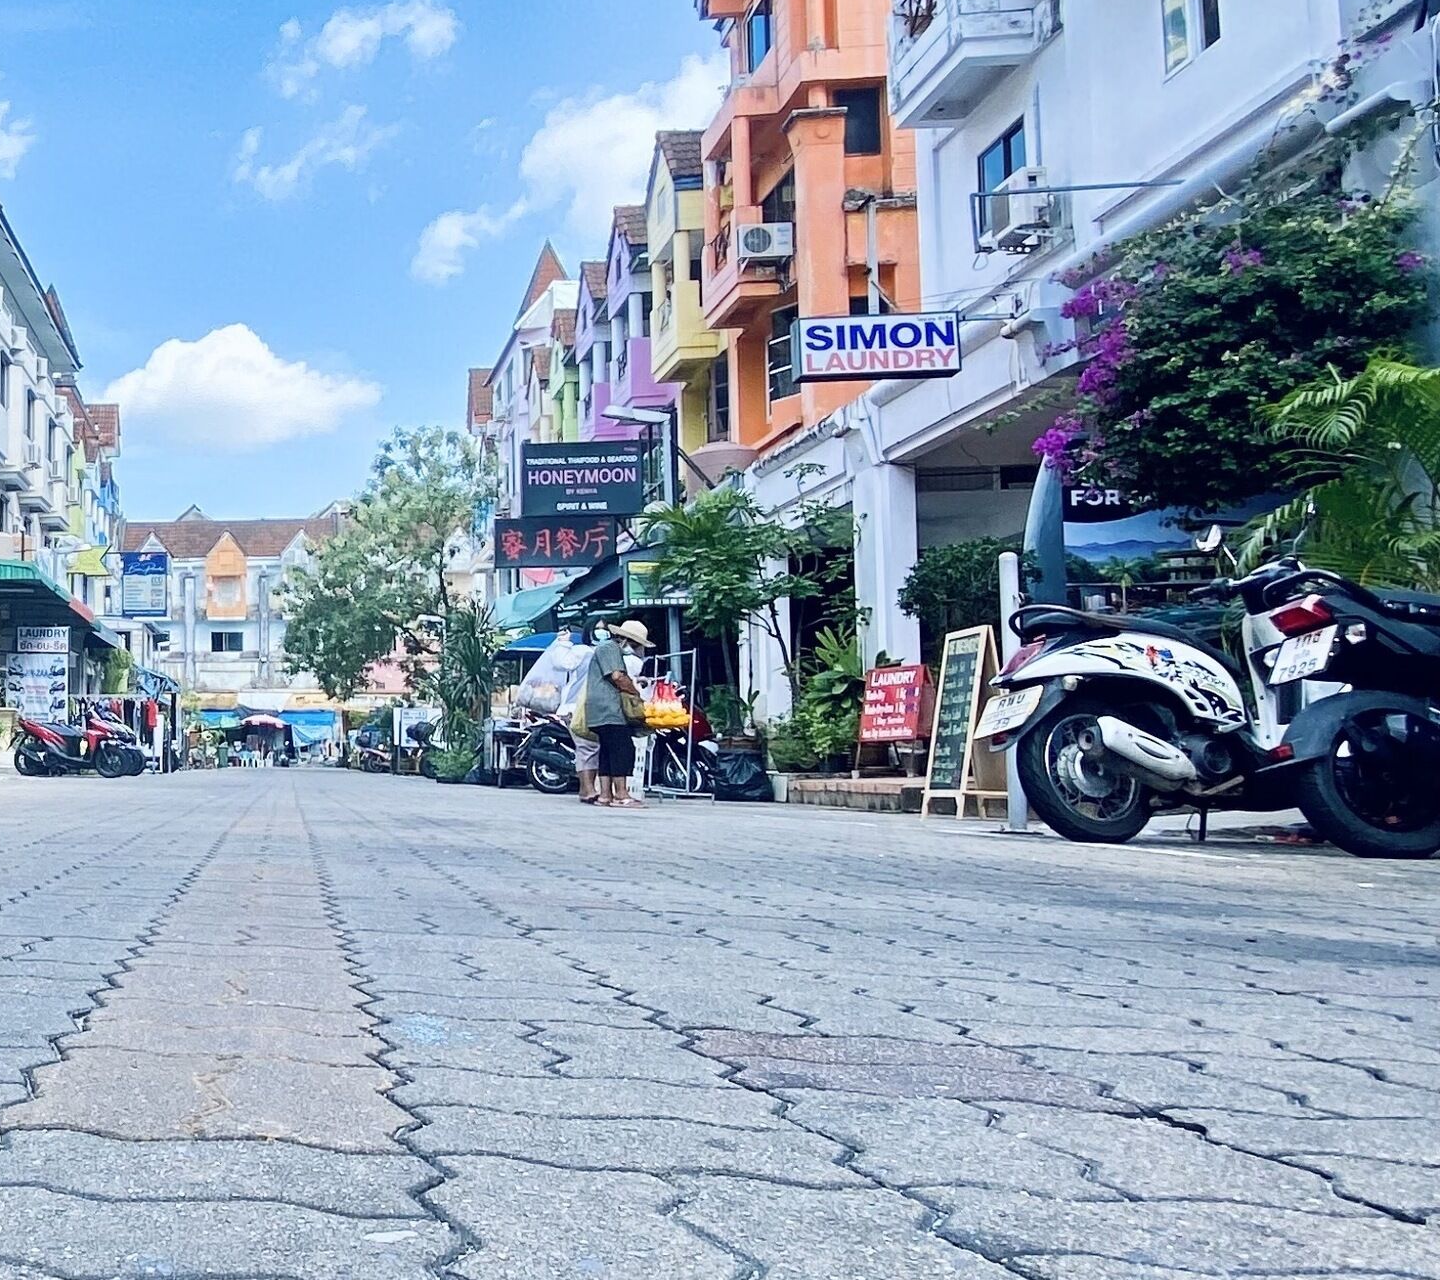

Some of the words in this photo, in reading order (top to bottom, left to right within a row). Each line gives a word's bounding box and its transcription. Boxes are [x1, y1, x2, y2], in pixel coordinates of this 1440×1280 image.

[805, 320, 956, 351] SIMON
[806, 348, 956, 372] LAUNDRY
[607, 454, 638, 463] SEAFOOD
[527, 467, 637, 486] HONEYMOON
[1070, 489, 1120, 506] FOR
[20, 628, 68, 638] LAUNDRY
[870, 670, 917, 687] LAUNDRY
